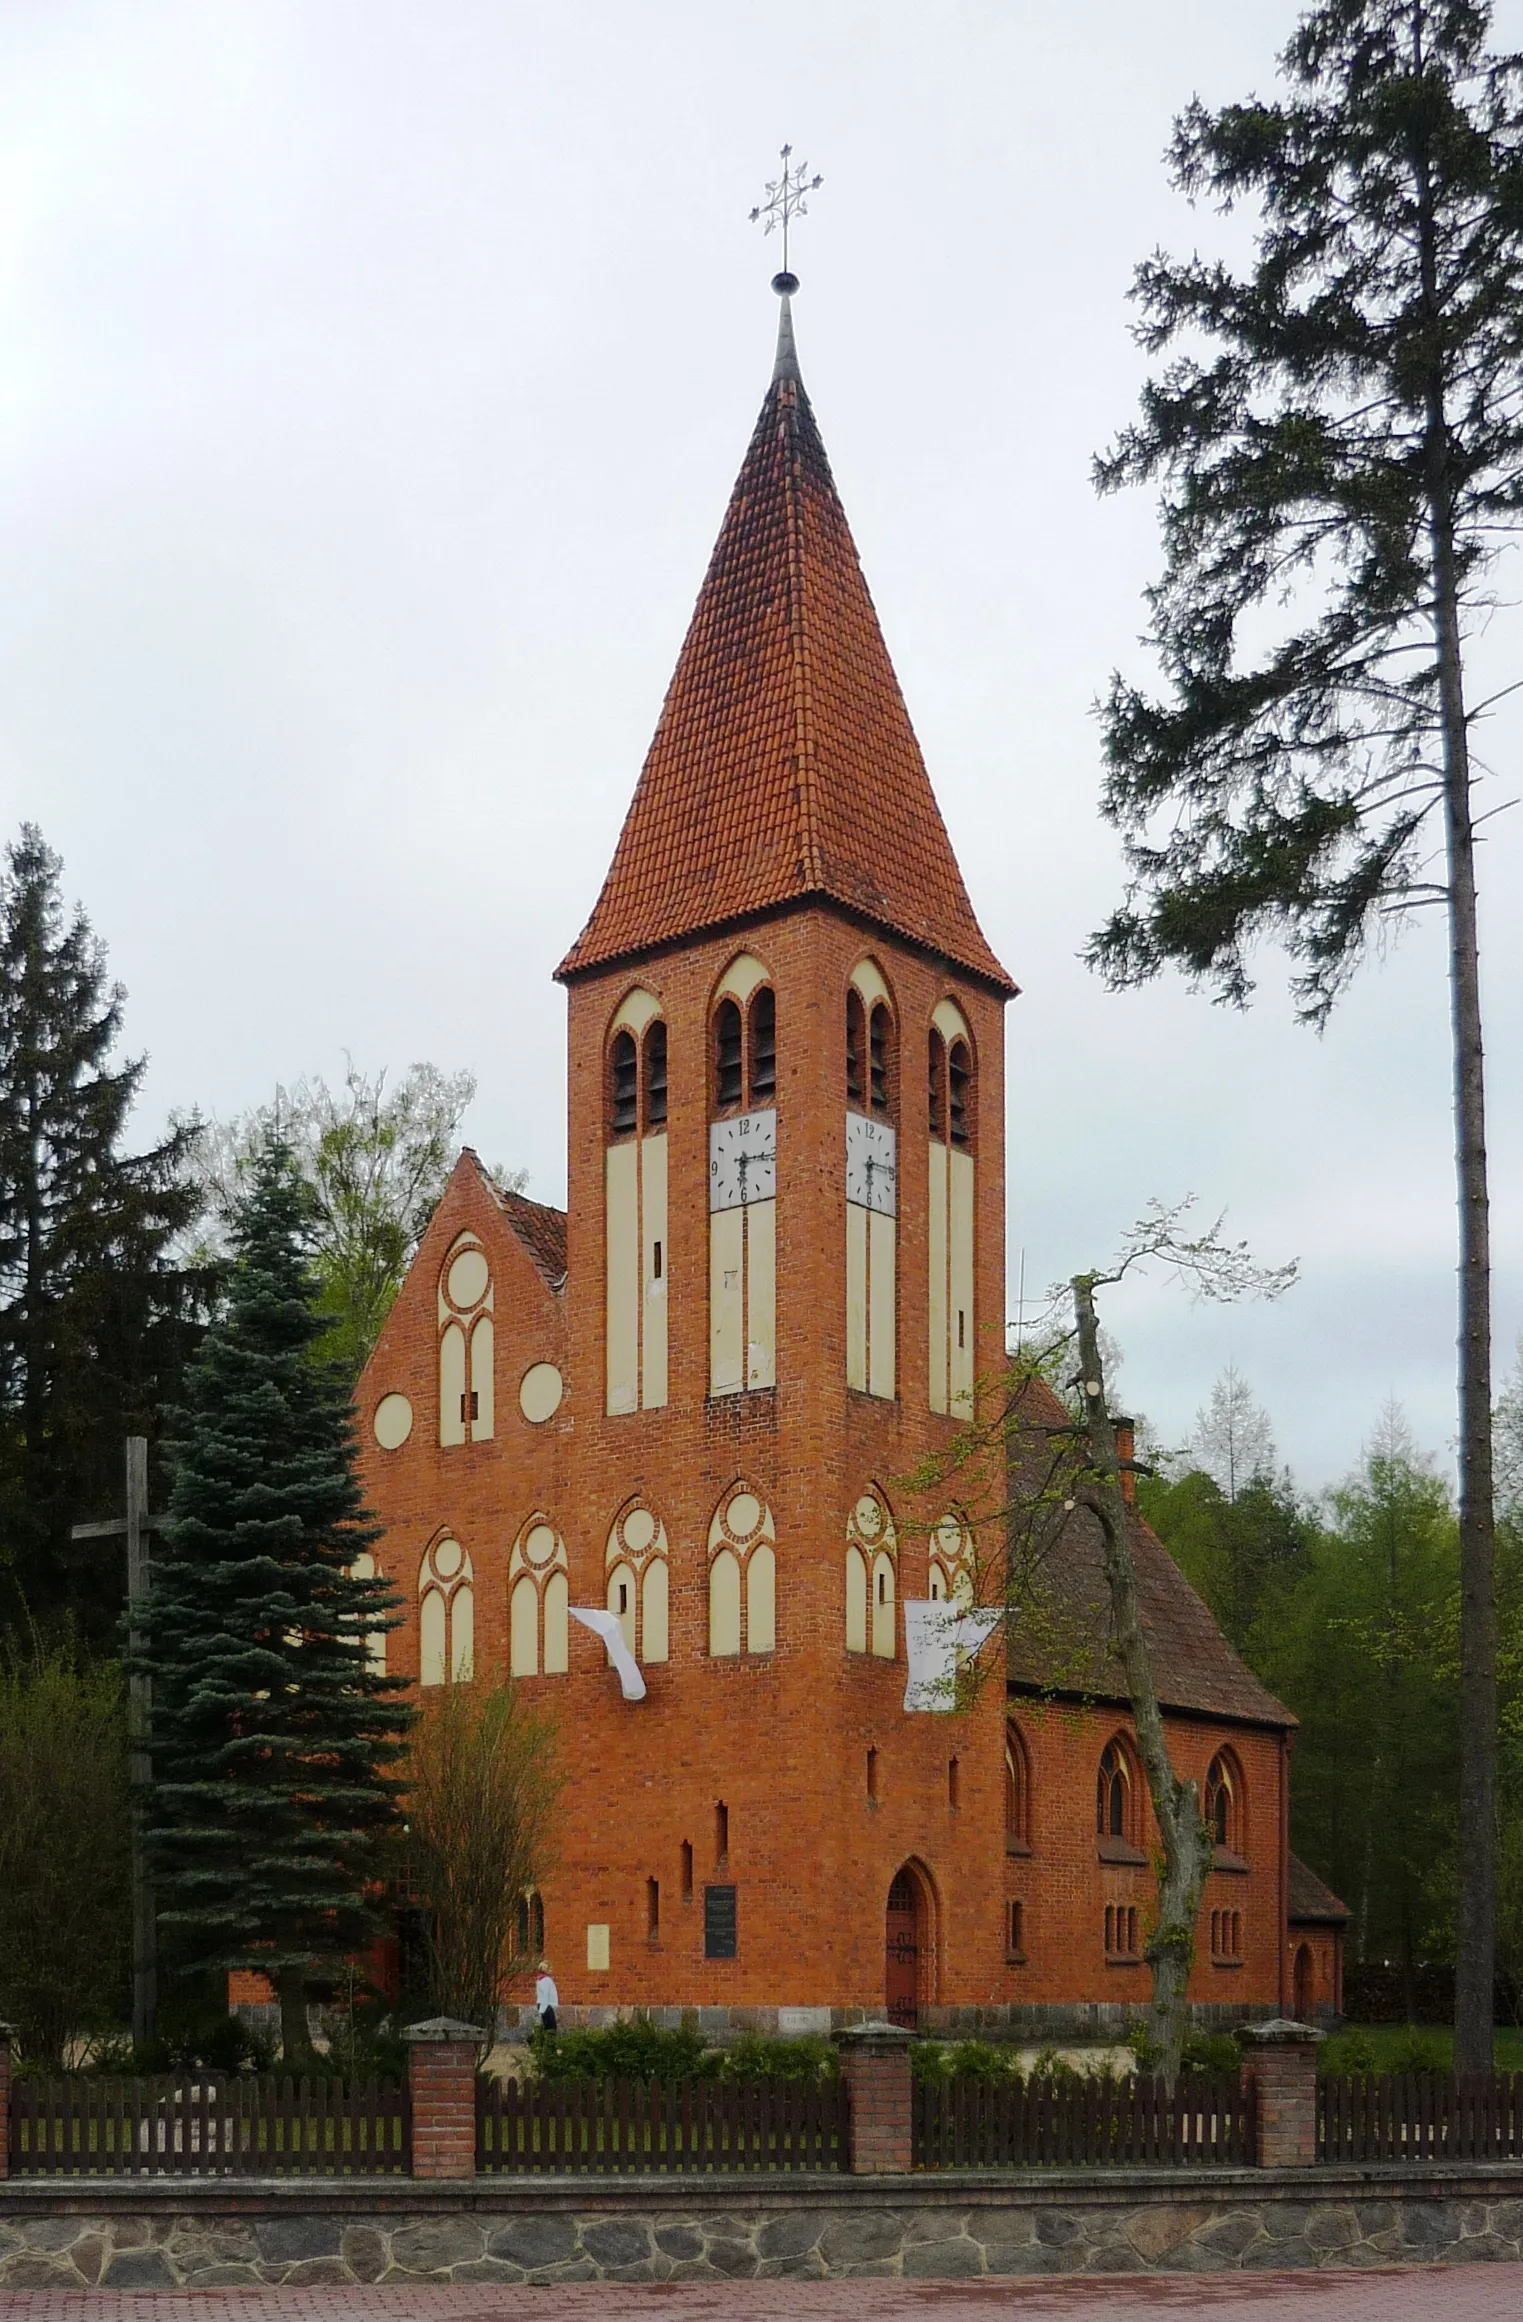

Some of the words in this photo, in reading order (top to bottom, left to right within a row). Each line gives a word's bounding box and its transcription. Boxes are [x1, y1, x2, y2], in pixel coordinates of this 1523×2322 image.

[739, 1119, 750, 1136] 12
[865, 1122, 875, 1140] 12
[711, 1161, 718, 1176] 9
[740, 1187, 747, 1202] 6
[866, 1191, 872, 1206] 6
